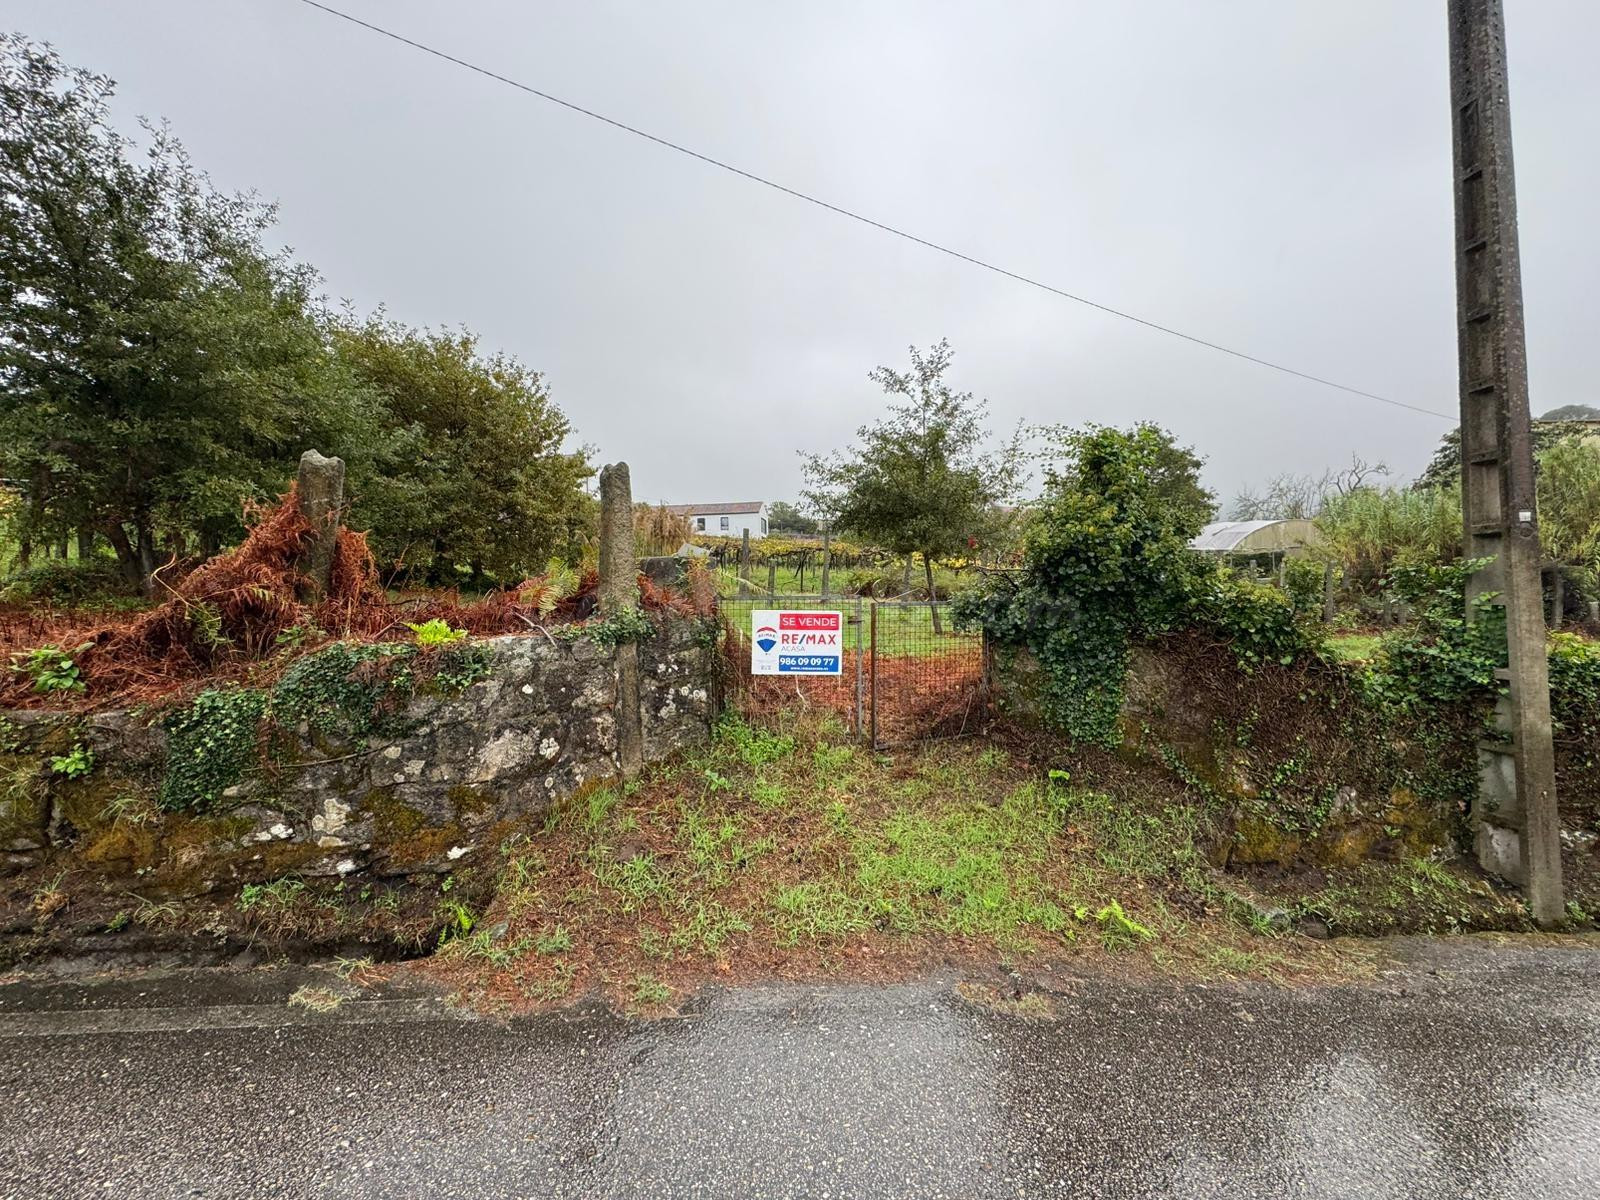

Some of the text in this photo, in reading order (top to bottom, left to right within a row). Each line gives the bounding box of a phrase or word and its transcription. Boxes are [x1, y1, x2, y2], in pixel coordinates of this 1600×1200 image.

[782, 618, 837, 626] SE VENDE
[781, 634, 836, 645] RE/MAX
[780, 658, 834, 666] 986 09 09 77
